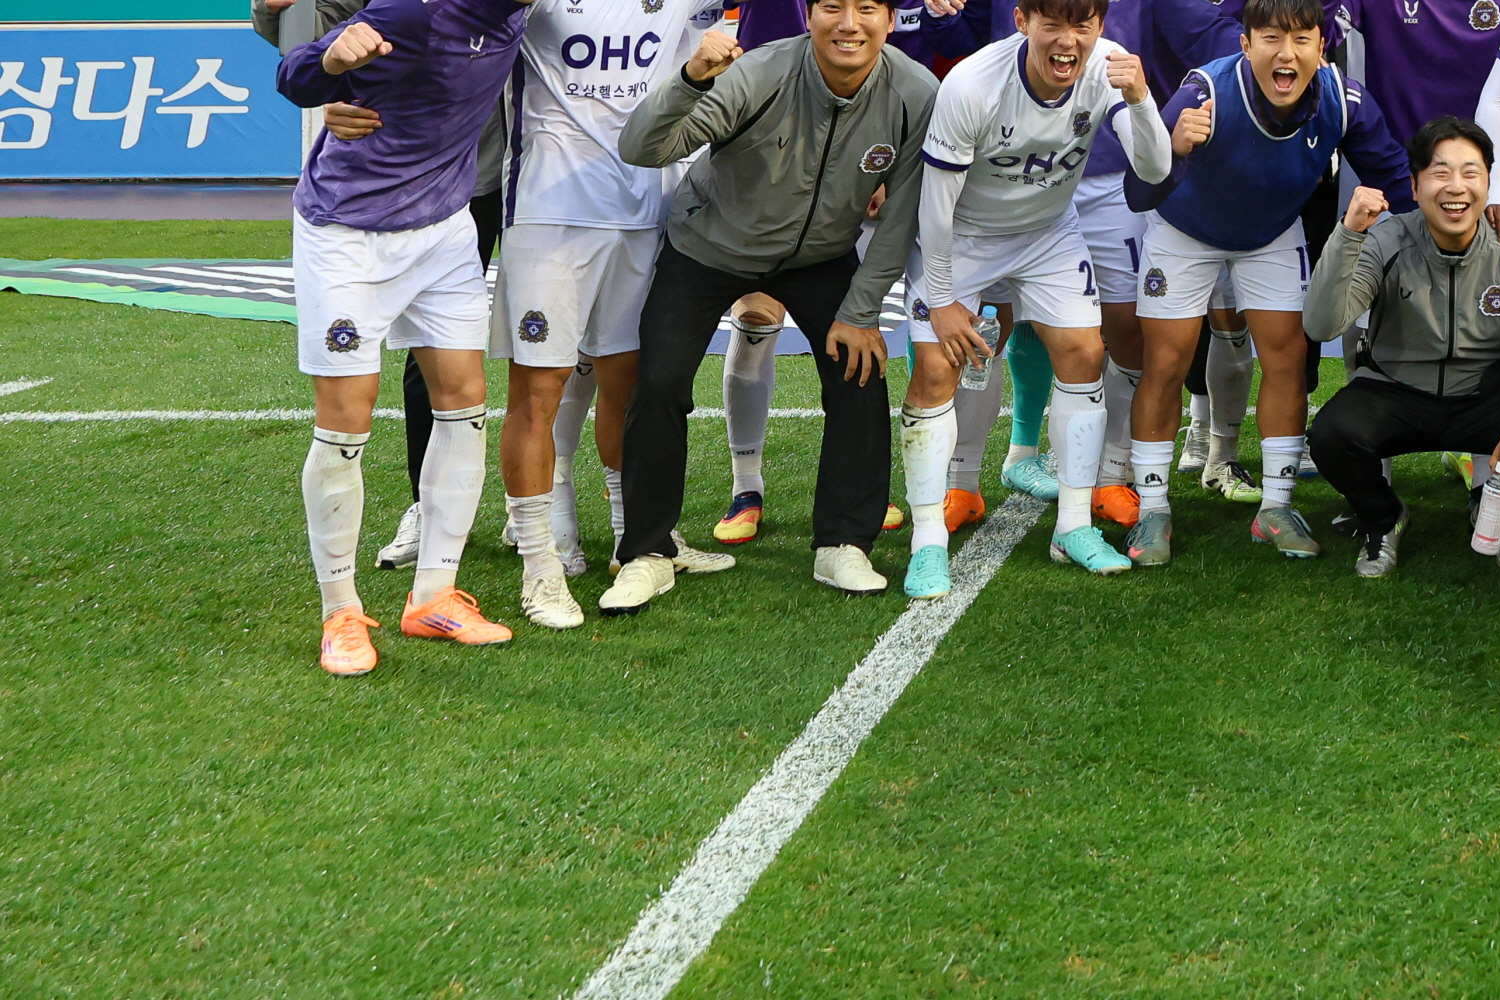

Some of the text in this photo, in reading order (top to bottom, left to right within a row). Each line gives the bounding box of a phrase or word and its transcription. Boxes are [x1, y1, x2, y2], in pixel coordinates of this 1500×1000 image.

[565, 7, 582, 15] VEXX
[900, 15, 919, 24] VEX
[561, 30, 662, 71] OHC
[0, 56, 250, 150] 삼다수
[987, 145, 1088, 175] OHC
